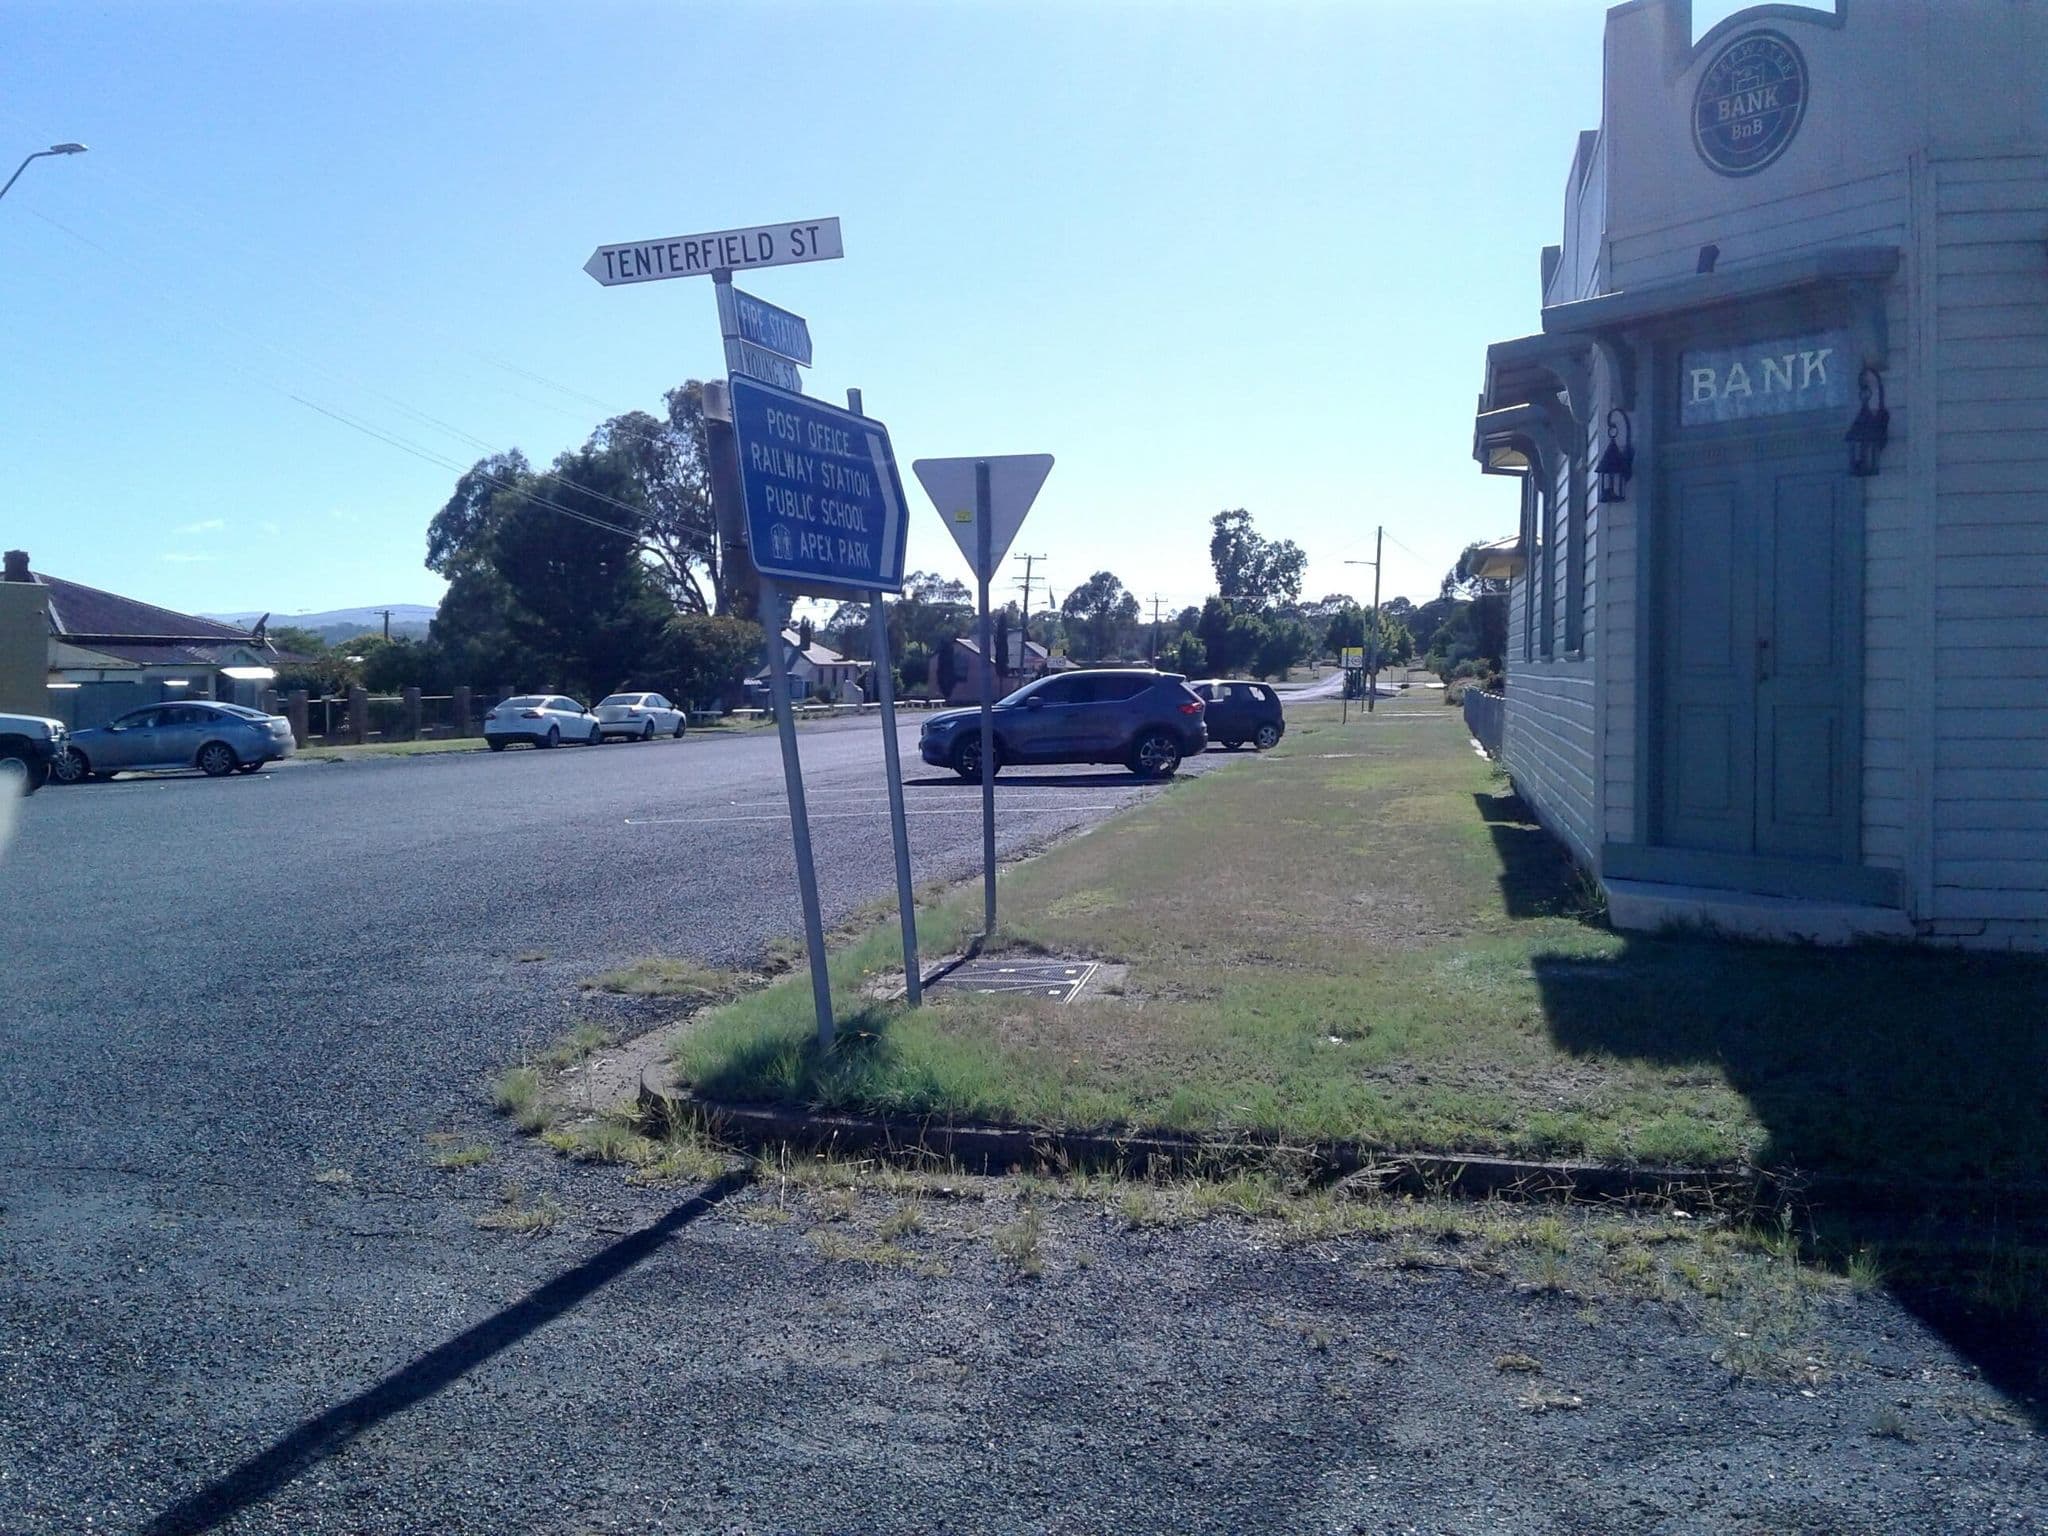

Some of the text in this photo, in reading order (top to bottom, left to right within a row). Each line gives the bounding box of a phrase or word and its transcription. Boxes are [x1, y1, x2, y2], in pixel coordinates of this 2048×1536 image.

[1717, 86, 1779, 121] BANK
[1731, 119, 1763, 140] BnB
[602, 226, 819, 279] TENTERFIELD ST
[740, 300, 808, 361] FIRE STATION
[744, 351, 795, 390] YOUNG ST
[1687, 348, 1833, 407] BANK
[766, 408, 850, 457] POST OFFICE
[751, 442, 871, 498] RAILWAY STATION
[765, 485, 868, 533] PUBLIC SCHOOL
[800, 531, 871, 569] APEX PARK
